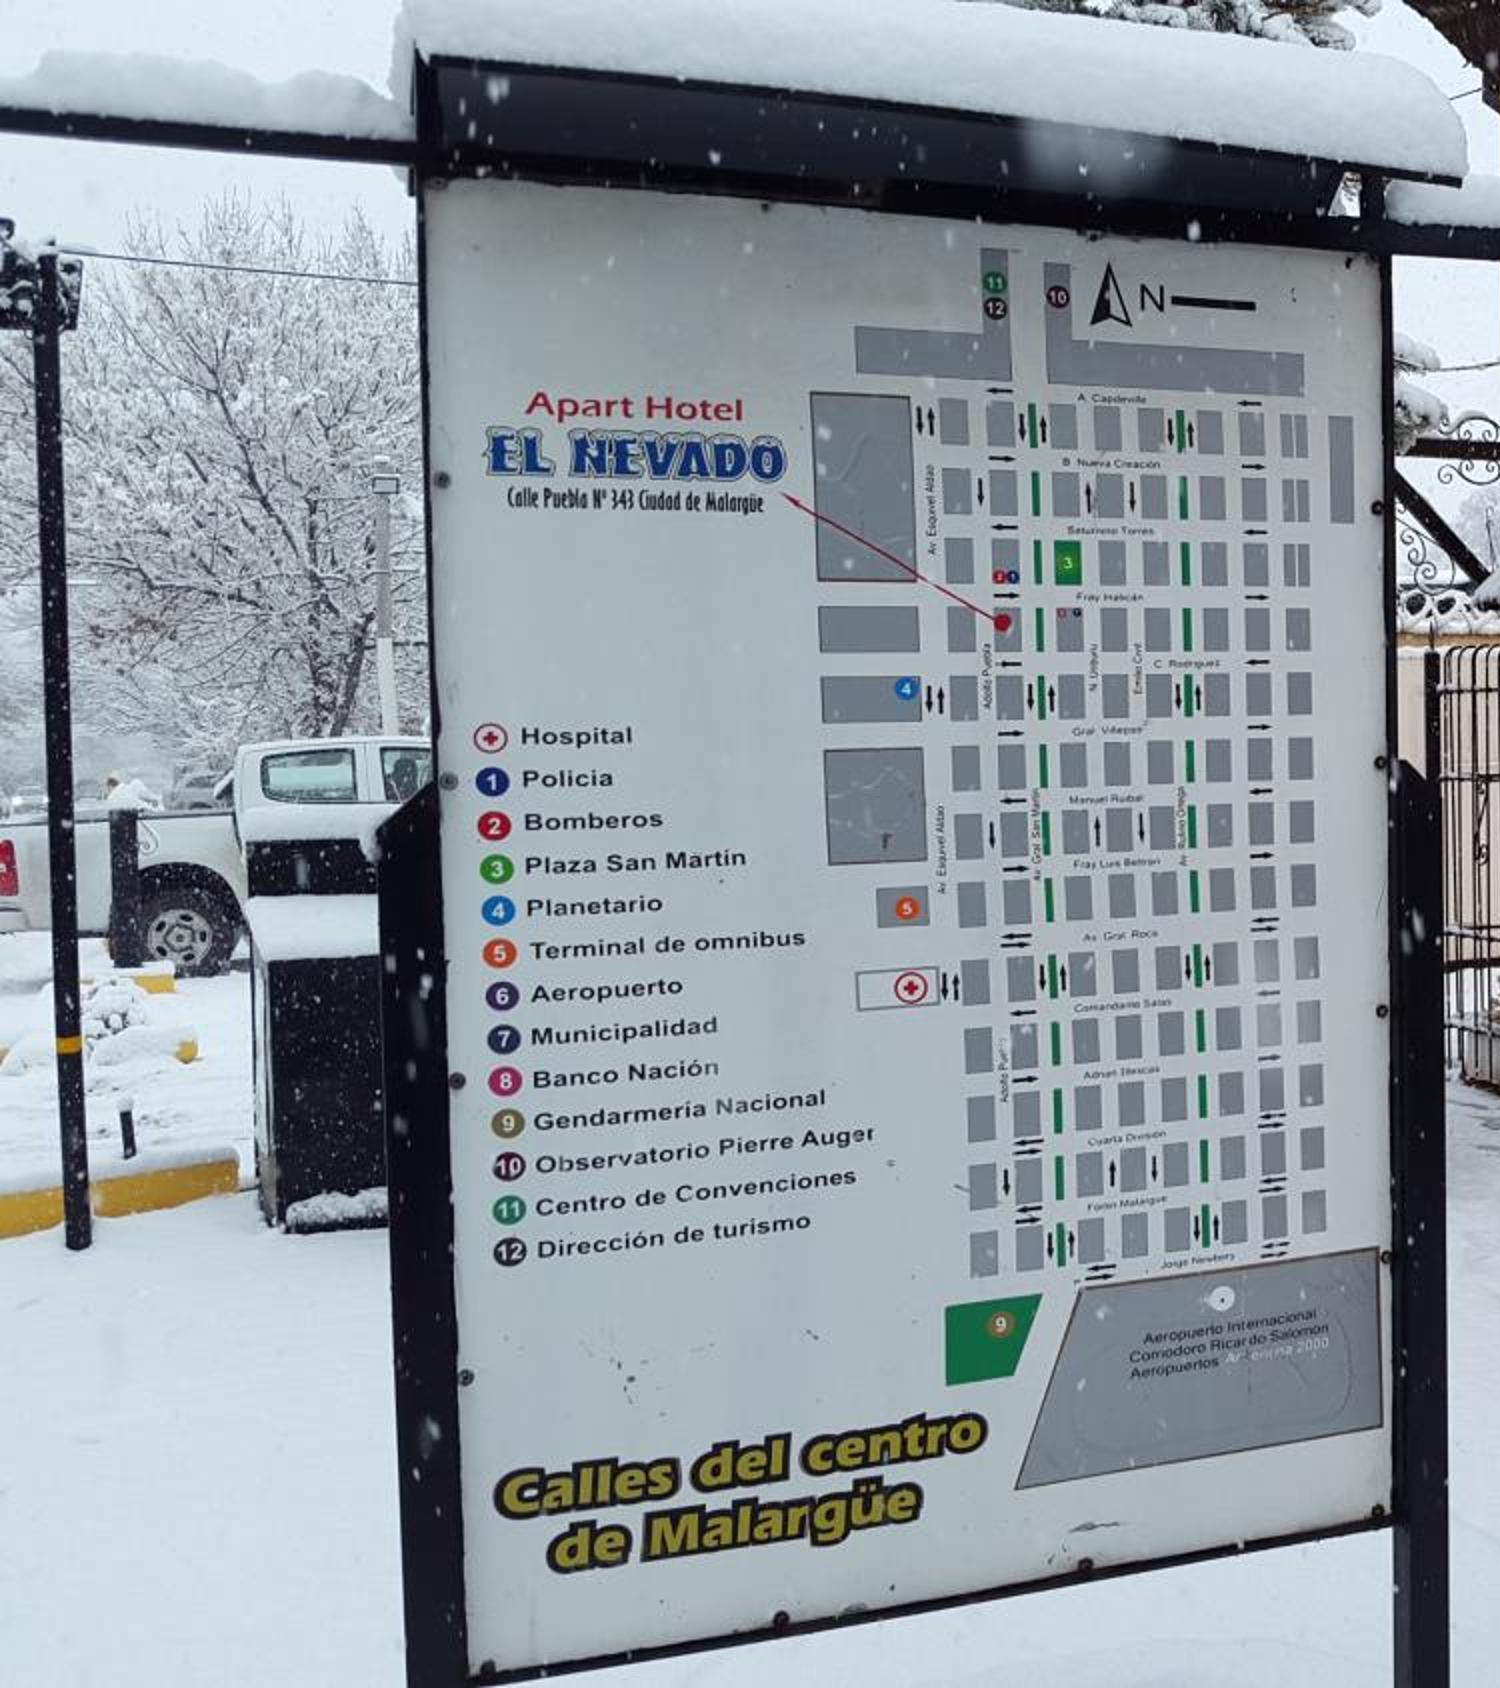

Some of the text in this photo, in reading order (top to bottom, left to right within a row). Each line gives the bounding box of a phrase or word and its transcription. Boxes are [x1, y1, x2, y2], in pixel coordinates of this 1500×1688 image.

[986, 302, 1005, 316] 12
[1049, 290, 1067, 304] 10
[1140, 284, 1165, 312] N
[525, 391, 744, 423] Apart Hotel
[482, 426, 788, 484] EL NEVADO
[507, 486, 539, 509] Calle
[543, 487, 588, 509] Puebla
[611, 489, 634, 510] 343
[639, 490, 682, 511] Ciudad
[685, 490, 701, 511] de
[706, 491, 764, 515] Malargüe
[1063, 556, 1073, 569] 3
[900, 682, 913, 697] 4
[520, 726, 633, 752] Hospital
[486, 769, 613, 790] 1 Policia
[488, 811, 664, 835] 2 Bomberos
[491, 849, 746, 878] 3 Plaza San Martin
[492, 897, 664, 919] 4 Planetario
[902, 901, 914, 916] 5
[494, 931, 806, 961] 5 Terminal de omnibus
[495, 977, 684, 1006] 6 Aeropuerto
[498, 1016, 719, 1048] 7 Municipalidad
[499, 1060, 720, 1090] 8 Banco Nación
[502, 1089, 827, 1132] 9 Gendarmería Nacional
[497, 1126, 875, 1176] 10 Observatorio Pierre Auger
[499, 1169, 857, 1218] 11 Centro de Convenciones
[498, 1213, 812, 1261] 12 Dirección de turismo
[995, 1315, 1007, 1333] 9
[1143, 1308, 1317, 1346] Aeropuerto Internacional
[1129, 1343, 1208, 1364] Comodoro
[1209, 1333, 1268, 1352] Ricardo
[1129, 1356, 1221, 1380] Aeropuertos
[494, 1413, 988, 1520] Calles del centro
[547, 1475, 925, 1575] de Malargüe
